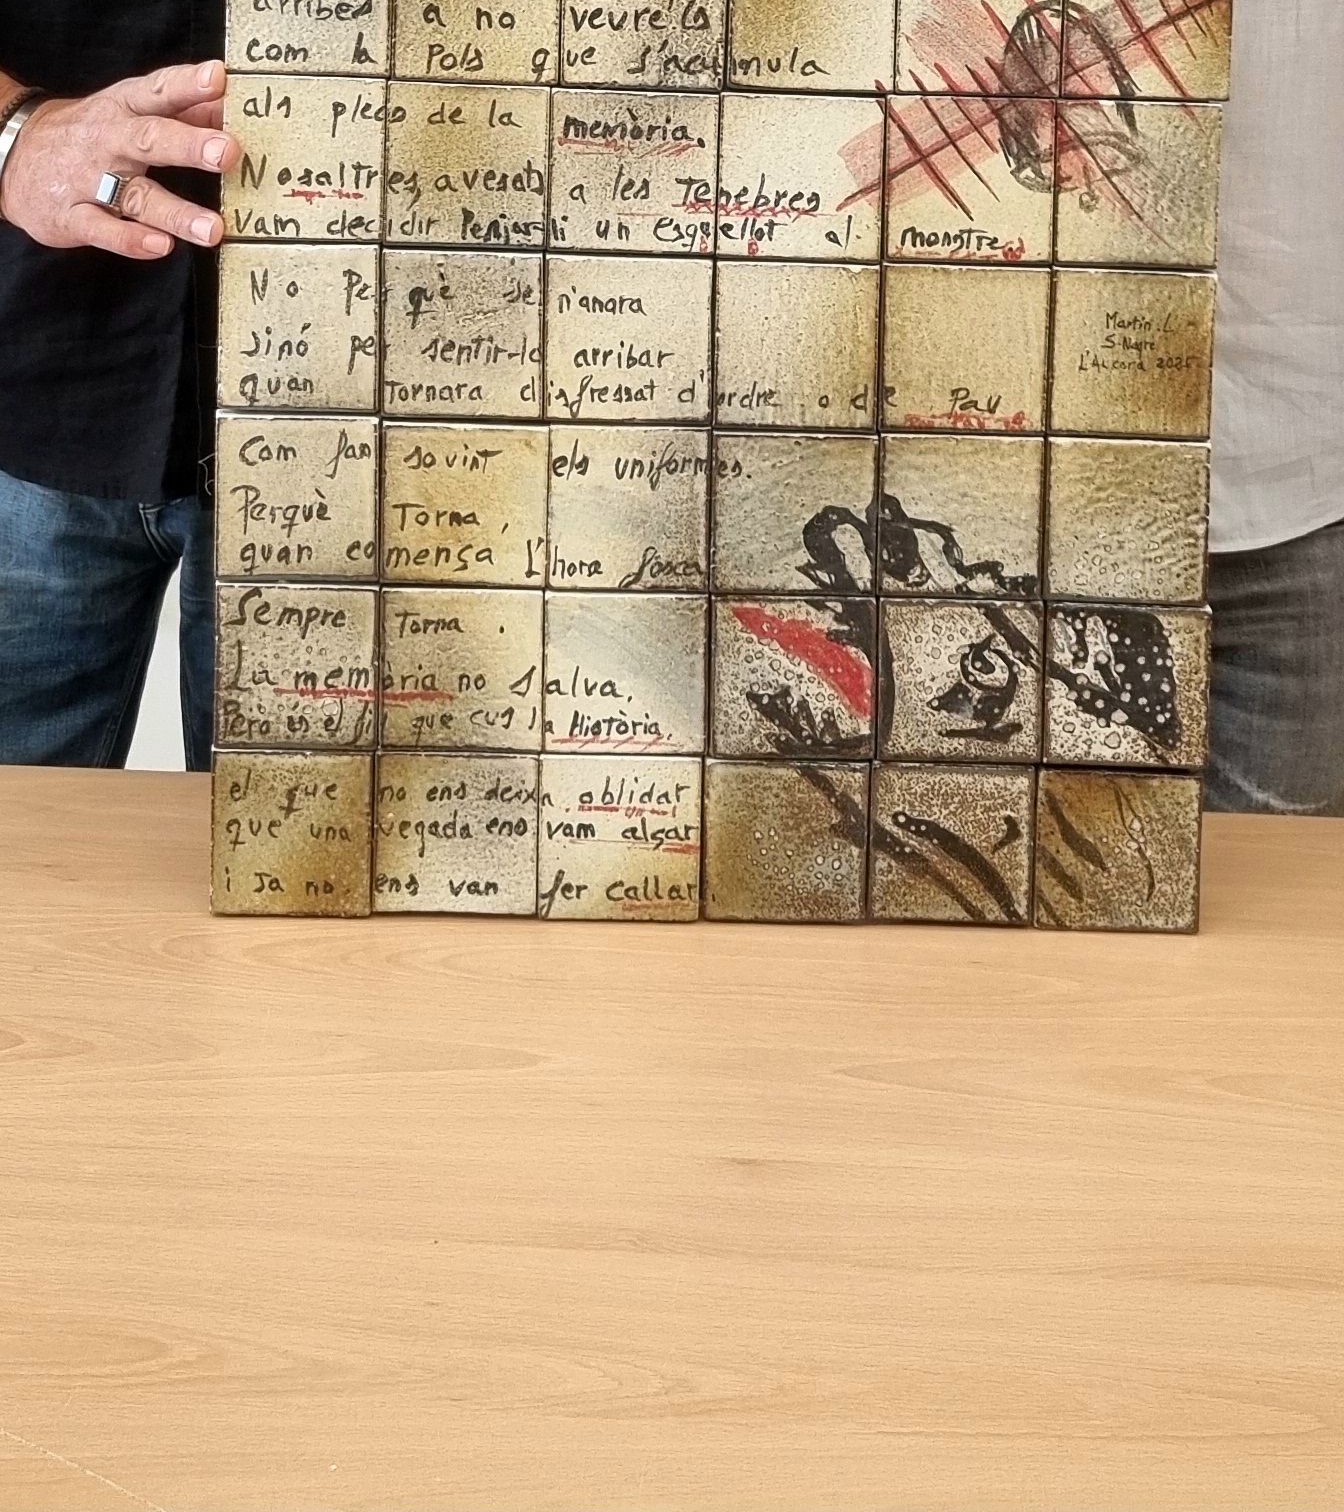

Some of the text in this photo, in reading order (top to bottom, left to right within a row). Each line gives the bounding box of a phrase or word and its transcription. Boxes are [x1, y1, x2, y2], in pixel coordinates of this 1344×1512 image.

[422, 2, 448, 29] a
[475, 7, 517, 31] no
[426, 101, 467, 127] de
[487, 98, 523, 130] la
[568, 182, 587, 204] a
[595, 219, 632, 242] un
[248, 266, 302, 306] No
[572, 340, 675, 372] arribar
[239, 541, 314, 574] quan
[457, 672, 487, 693] no
